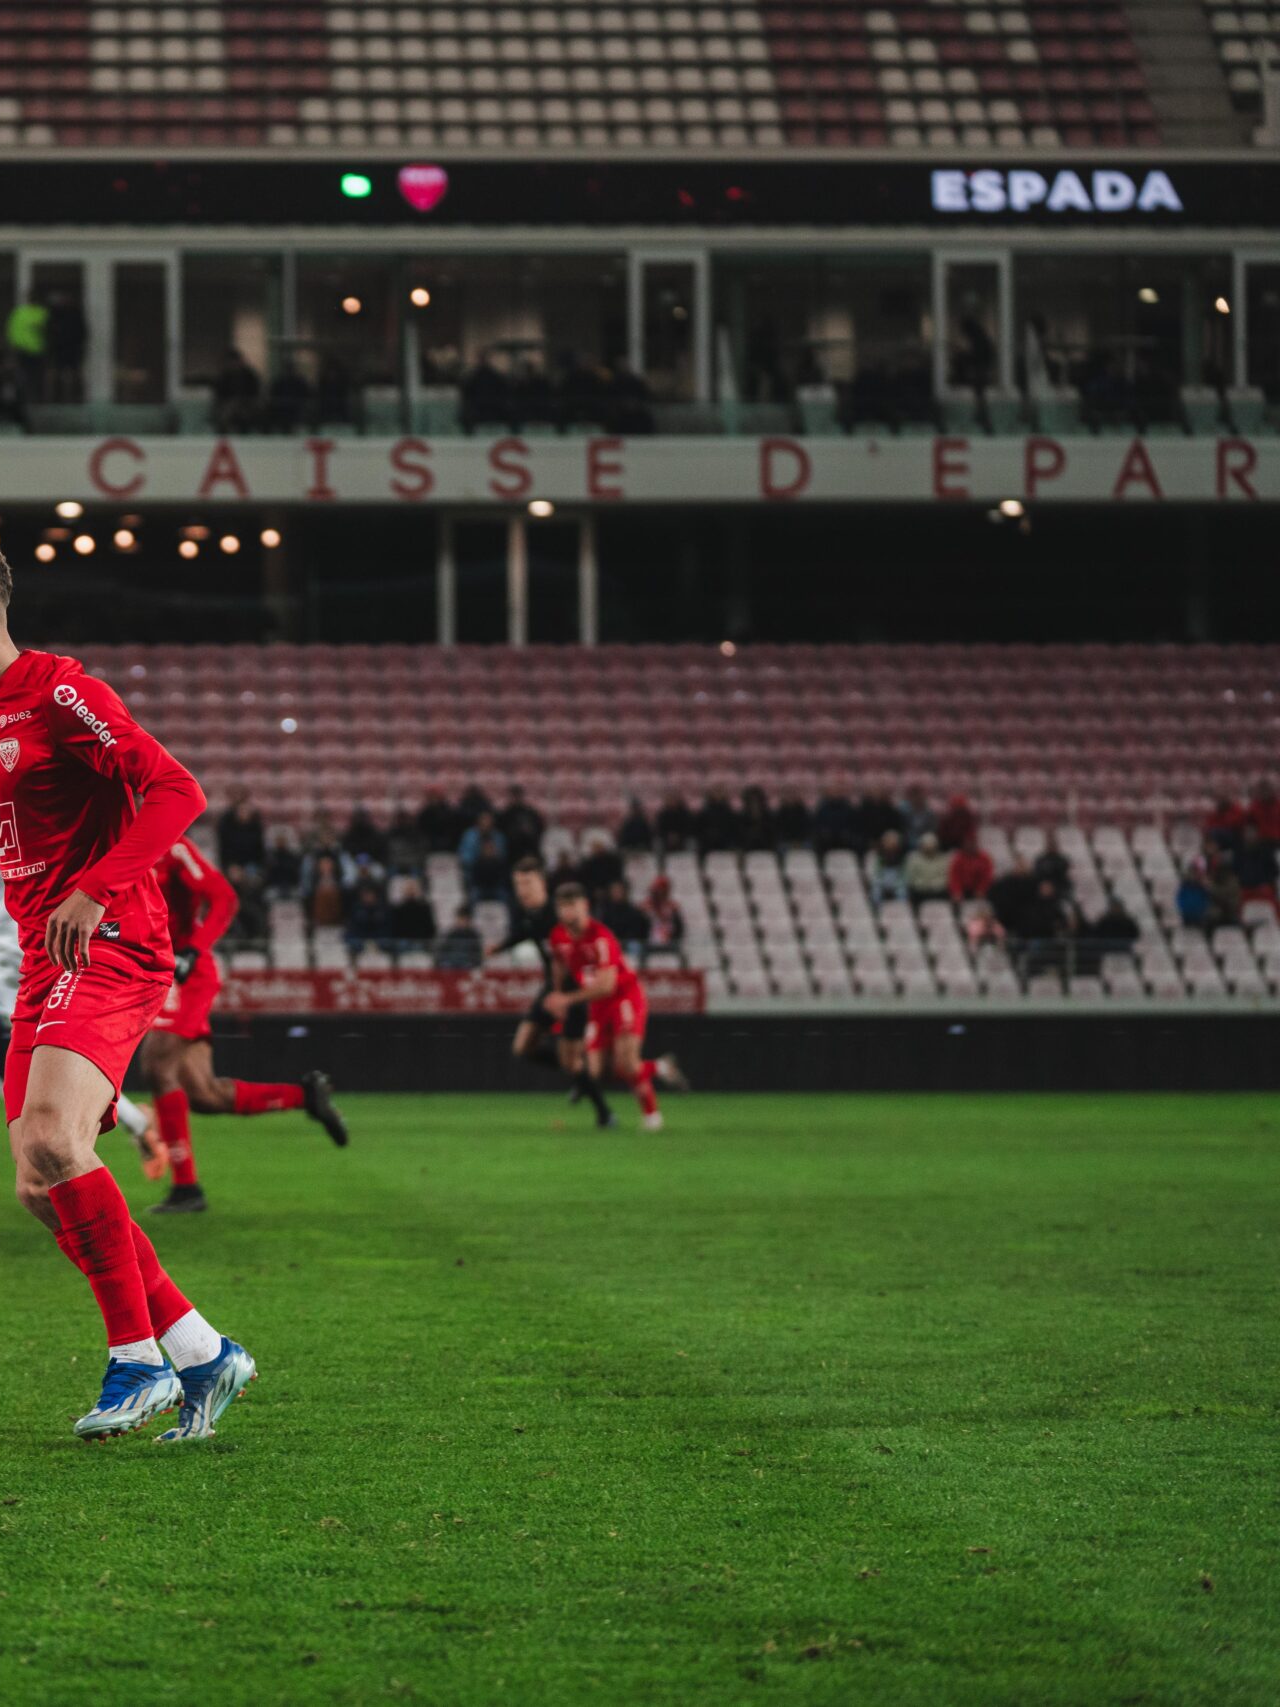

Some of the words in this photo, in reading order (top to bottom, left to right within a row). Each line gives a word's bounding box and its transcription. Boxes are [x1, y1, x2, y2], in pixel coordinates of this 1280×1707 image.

[931, 169, 1183, 212] ESPADA
[89, 437, 626, 499] CAISSE
[8, 710, 32, 723] suez
[73, 699, 118, 748] leader
[11, 863, 46, 877] MARTIN
